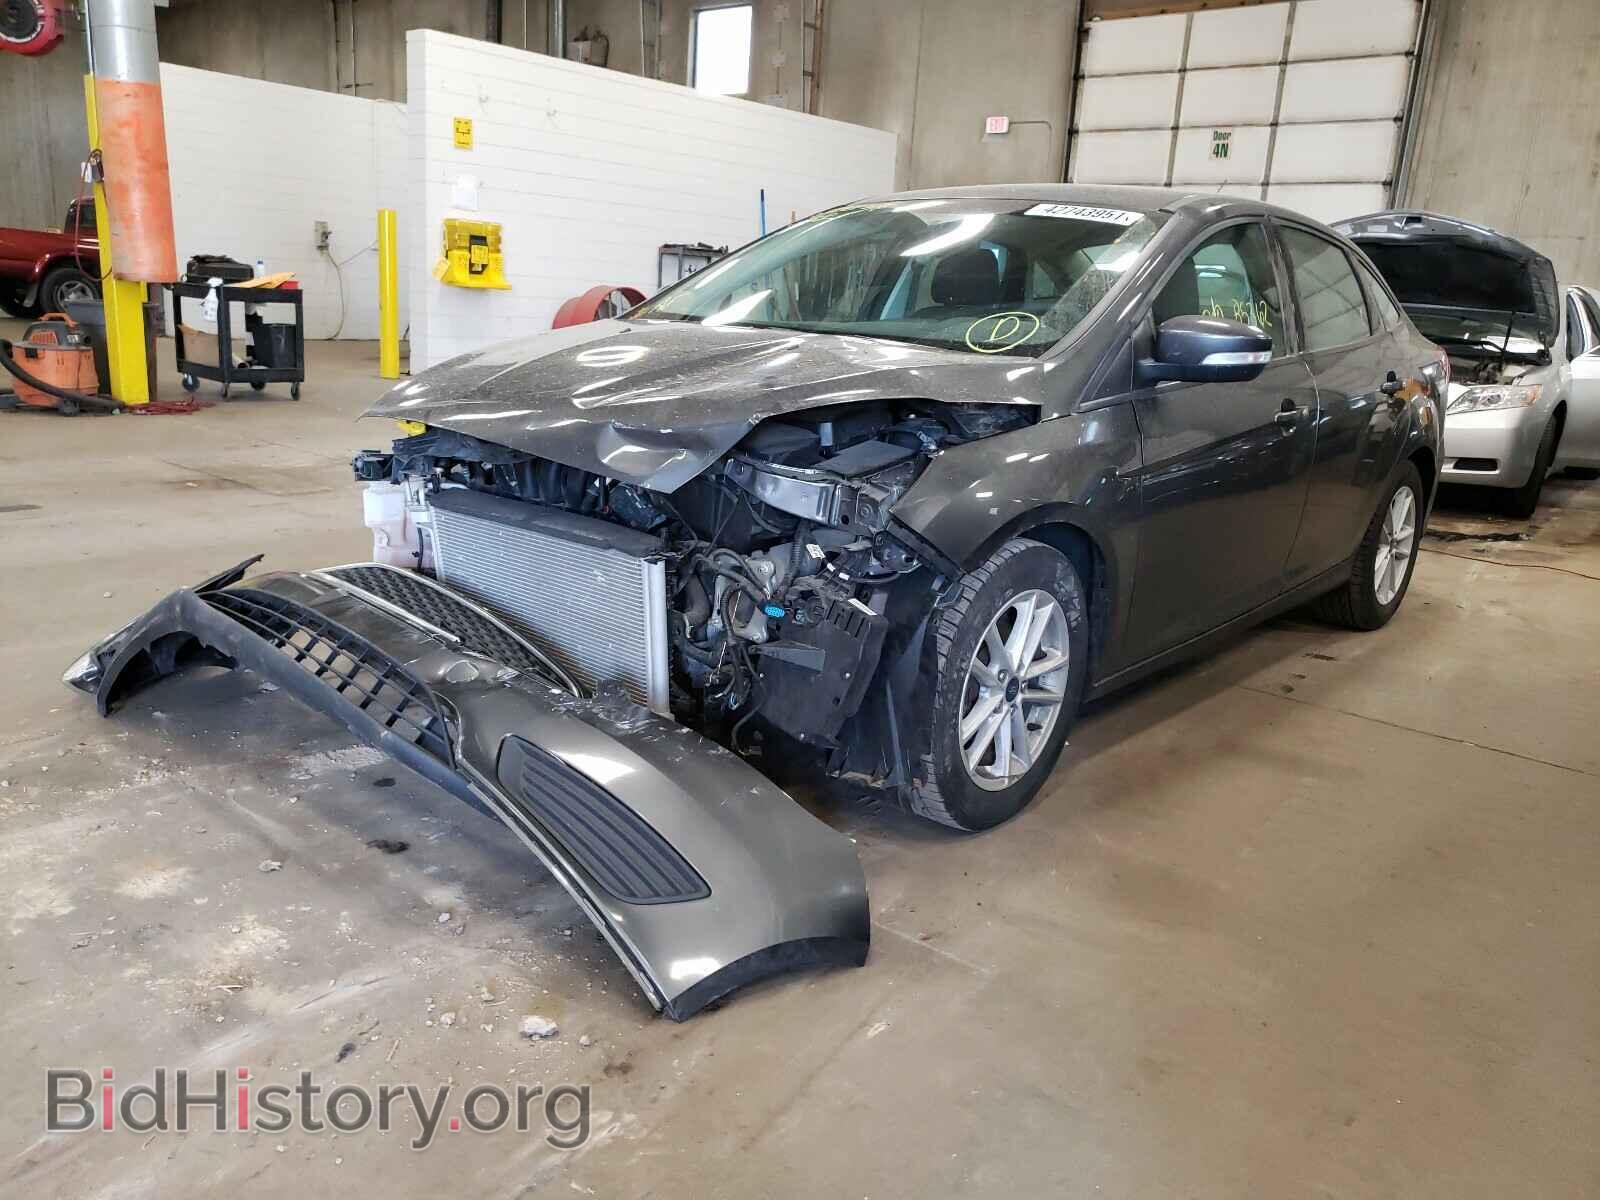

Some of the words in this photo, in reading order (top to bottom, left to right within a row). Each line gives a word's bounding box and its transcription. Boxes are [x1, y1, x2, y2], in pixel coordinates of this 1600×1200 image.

[1213, 130, 1231, 141] Door
[1212, 143, 1229, 158] 4N
[1043, 204, 1125, 221] 42743951
